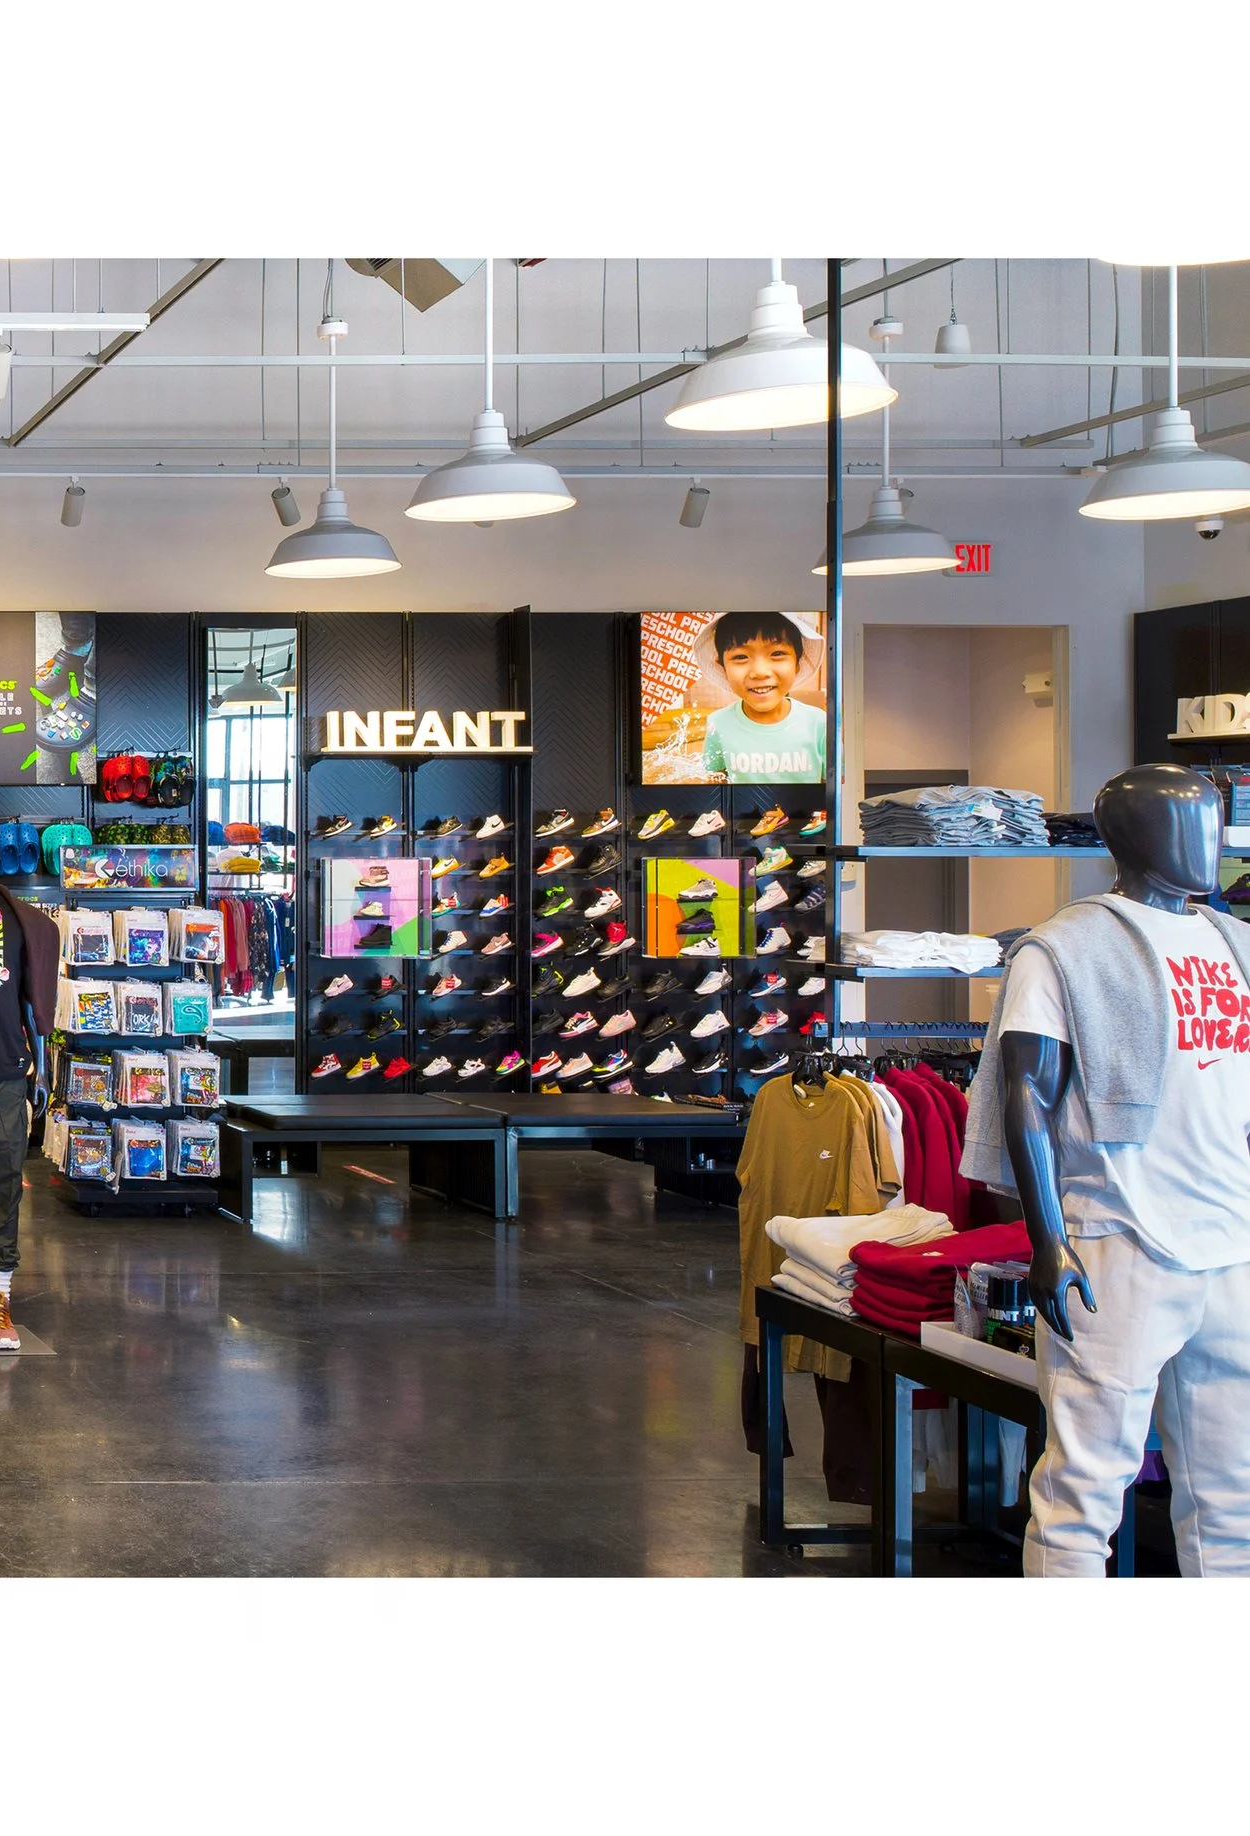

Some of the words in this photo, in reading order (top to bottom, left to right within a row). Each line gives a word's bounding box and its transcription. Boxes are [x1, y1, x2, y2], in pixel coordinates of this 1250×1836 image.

[955, 544, 991, 572] EXIT
[326, 710, 526, 749] INFANT
[115, 858, 168, 877] ethika
[1166, 956, 1239, 989] NIKE
[1171, 988, 1196, 1017] IS
[1177, 1017, 1250, 1054] LOVER
